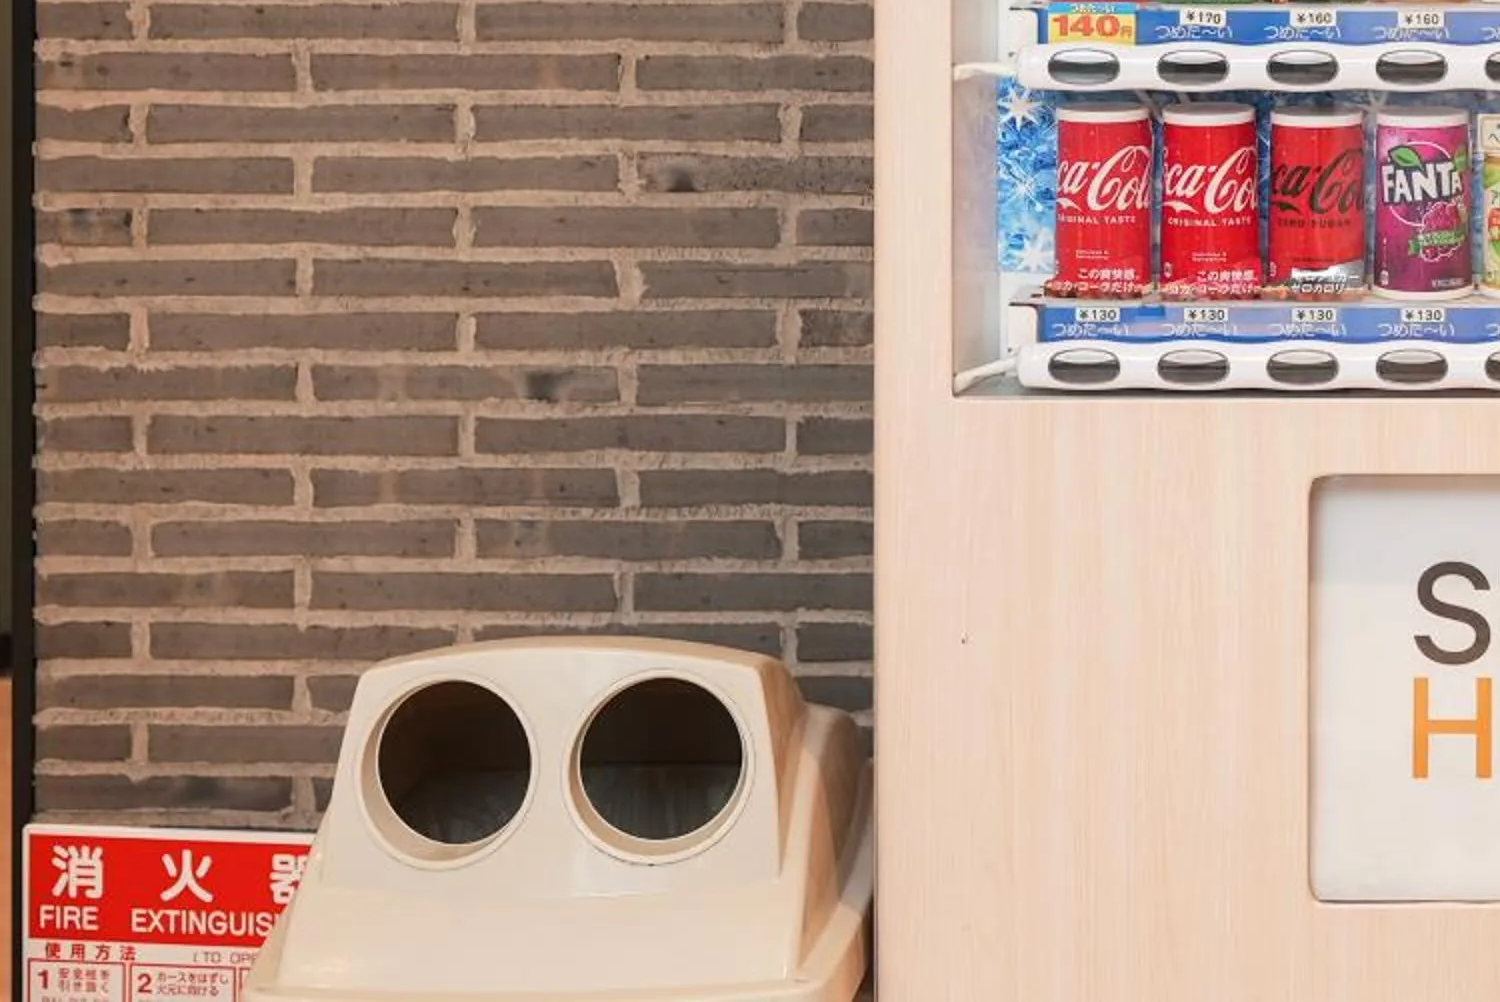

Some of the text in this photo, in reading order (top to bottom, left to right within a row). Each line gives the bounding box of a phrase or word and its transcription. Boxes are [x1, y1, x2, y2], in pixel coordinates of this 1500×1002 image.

[1186, 11, 1221, 24] ¥170
[1297, 12, 1332, 24] ¥160
[1405, 13, 1439, 25] ¥160
[1053, 16, 1132, 39] 140円
[1382, 163, 1463, 203] FANTA
[1105, 216, 1136, 224] TASTE
[1079, 310, 1116, 321] ¥130
[1188, 310, 1225, 321] ¥130
[1296, 310, 1334, 321] ¥130
[1404, 309, 1442, 321] ¥130
[39, 905, 281, 937] FIRE EXTINGUIS
[45, 942, 137, 961] 使用方法
[229, 952, 257, 965] OPE
[38, 970, 49, 989] 1
[137, 973, 153, 993] 2
